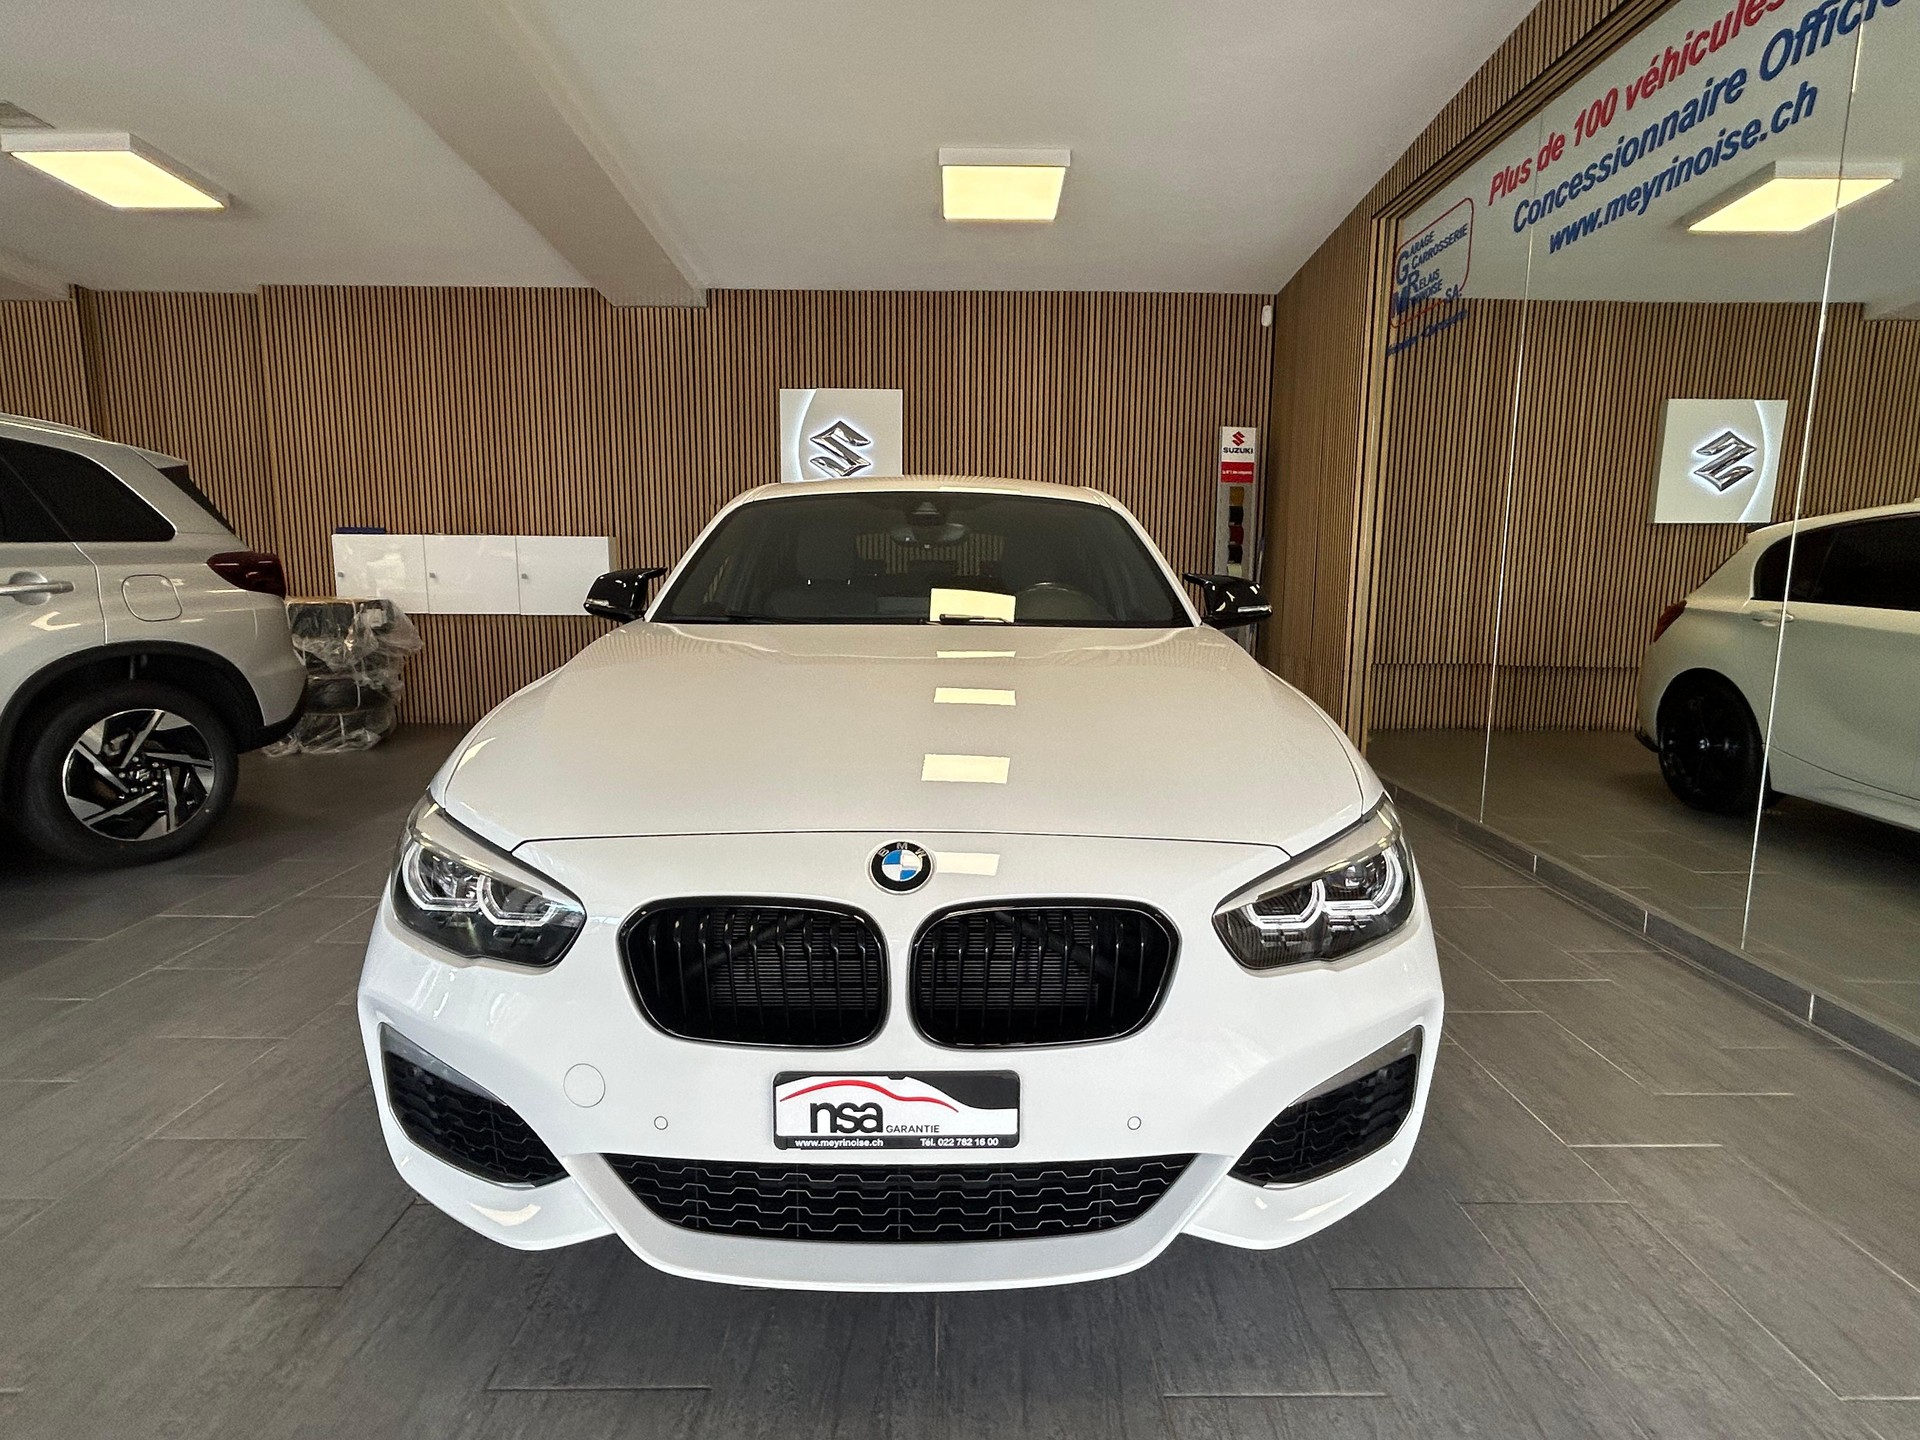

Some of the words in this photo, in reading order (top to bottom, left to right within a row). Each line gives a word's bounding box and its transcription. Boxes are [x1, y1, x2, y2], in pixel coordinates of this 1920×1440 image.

[1488, 157, 1533, 206] Plus
[1537, 131, 1566, 172] de
[1573, 87, 1619, 147] 100
[1512, 67, 1747, 234] Concessionnaire
[1549, 80, 1818, 255] www.meyrinoise.ch
[1412, 224, 1468, 269] CARROSSERIE
[1407, 268, 1441, 294] RELAIS
[1223, 447, 1253, 455] SUZUKI
[877, 842, 927, 859] BMW
[810, 1102, 883, 1133] nsa
[885, 1124, 940, 1134] GARANTIE
[794, 1138, 884, 1149] www.meyrinoise.ch
[937, 1137, 955, 1147] 022
[974, 1137, 986, 1147] 16
[987, 1137, 999, 1147] 00
